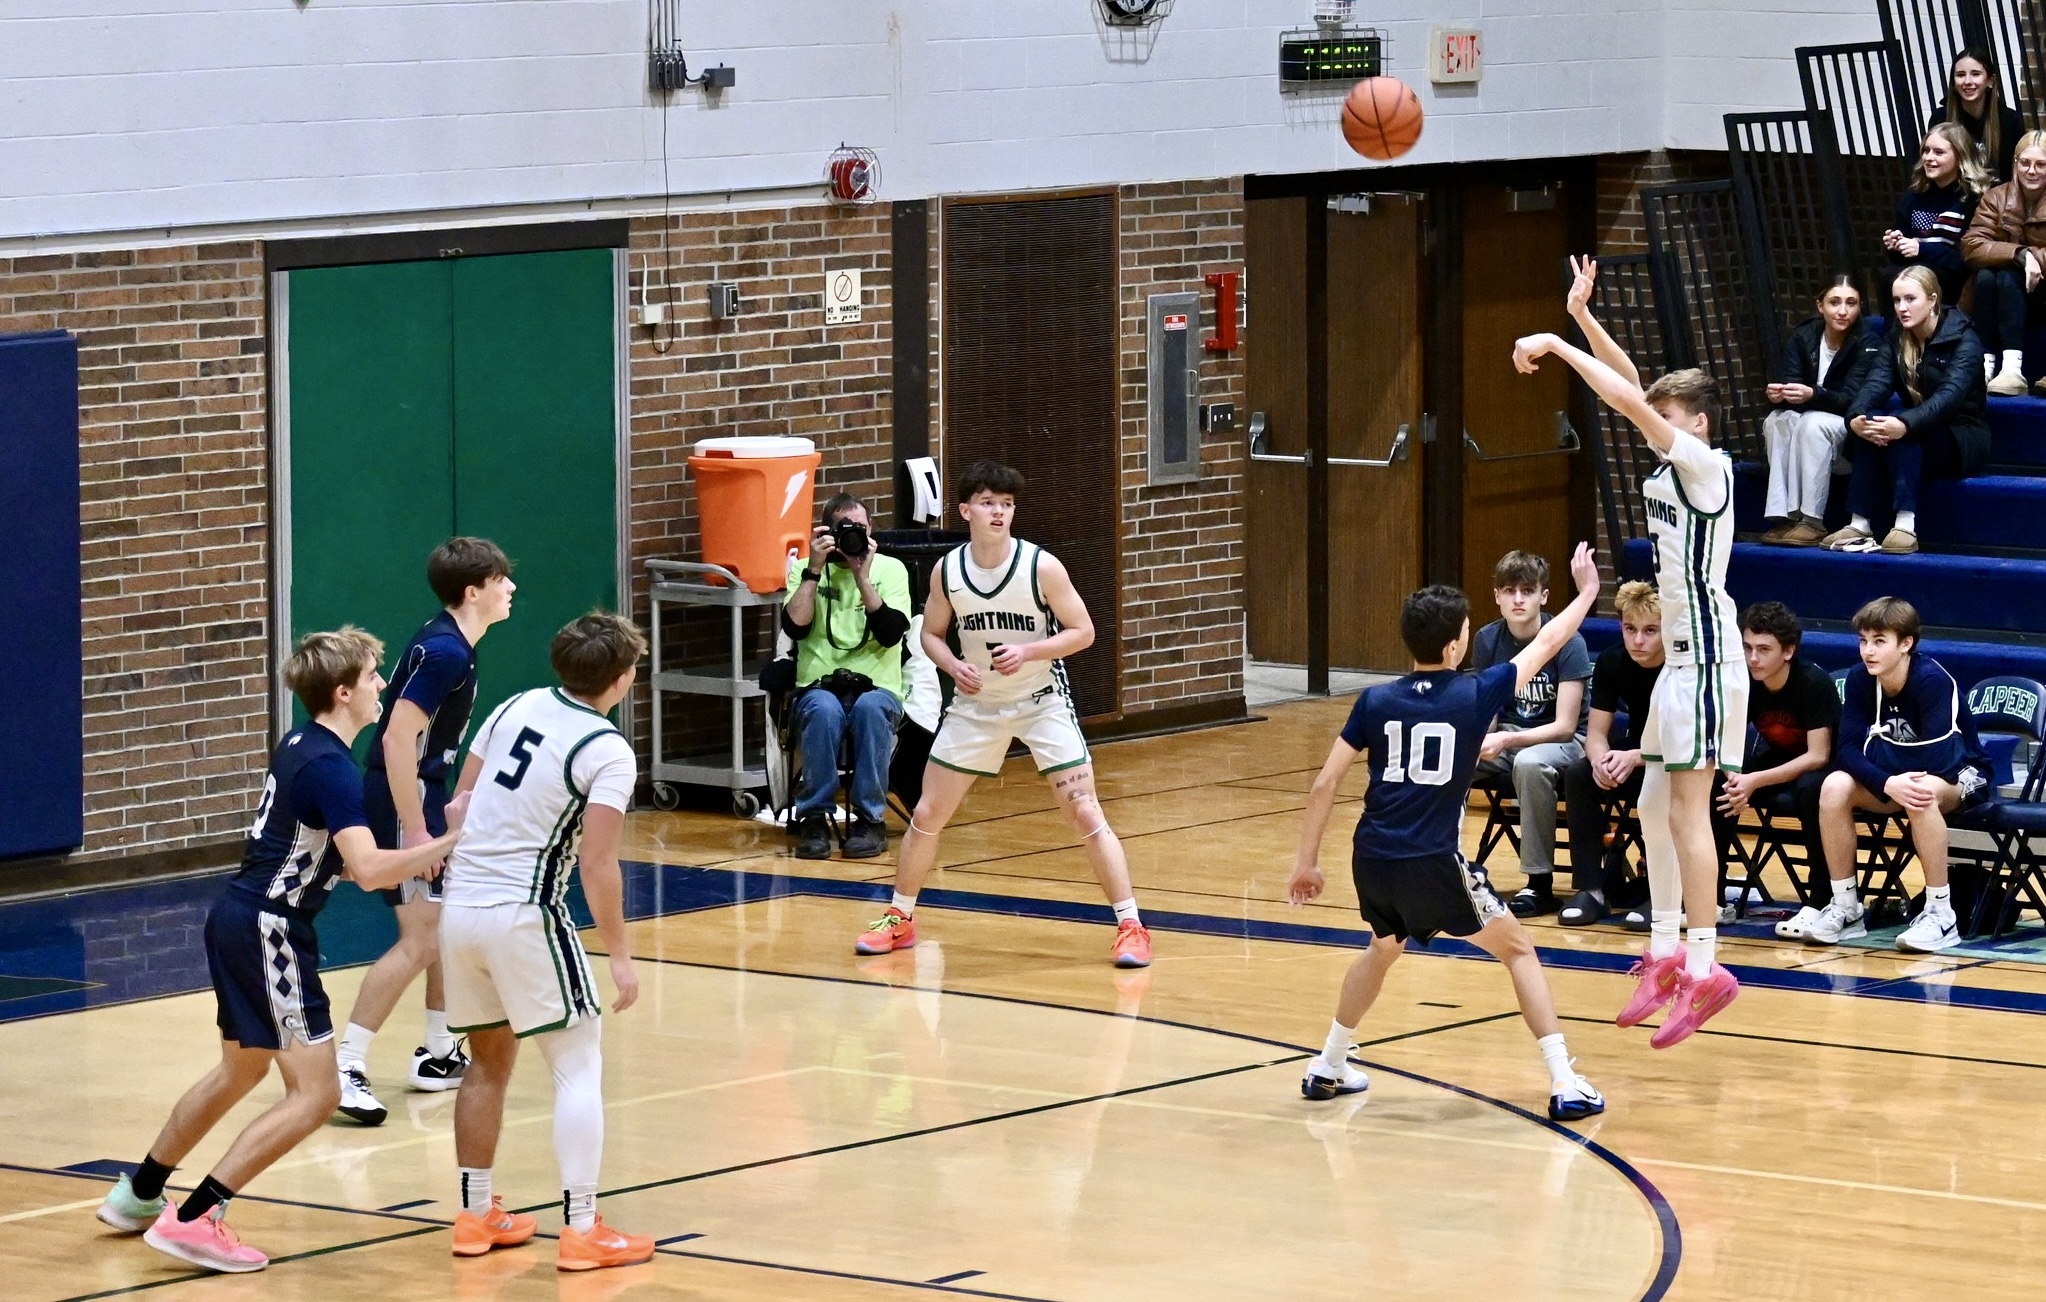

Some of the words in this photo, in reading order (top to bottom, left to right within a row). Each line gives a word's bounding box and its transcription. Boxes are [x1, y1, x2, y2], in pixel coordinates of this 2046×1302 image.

[1447, 36, 1476, 73] EXIT
[839, 304, 860, 312] HANGING
[1967, 686, 2038, 723] LAPEER
[494, 726, 545, 791] 5
[1382, 720, 1456, 786] 10
